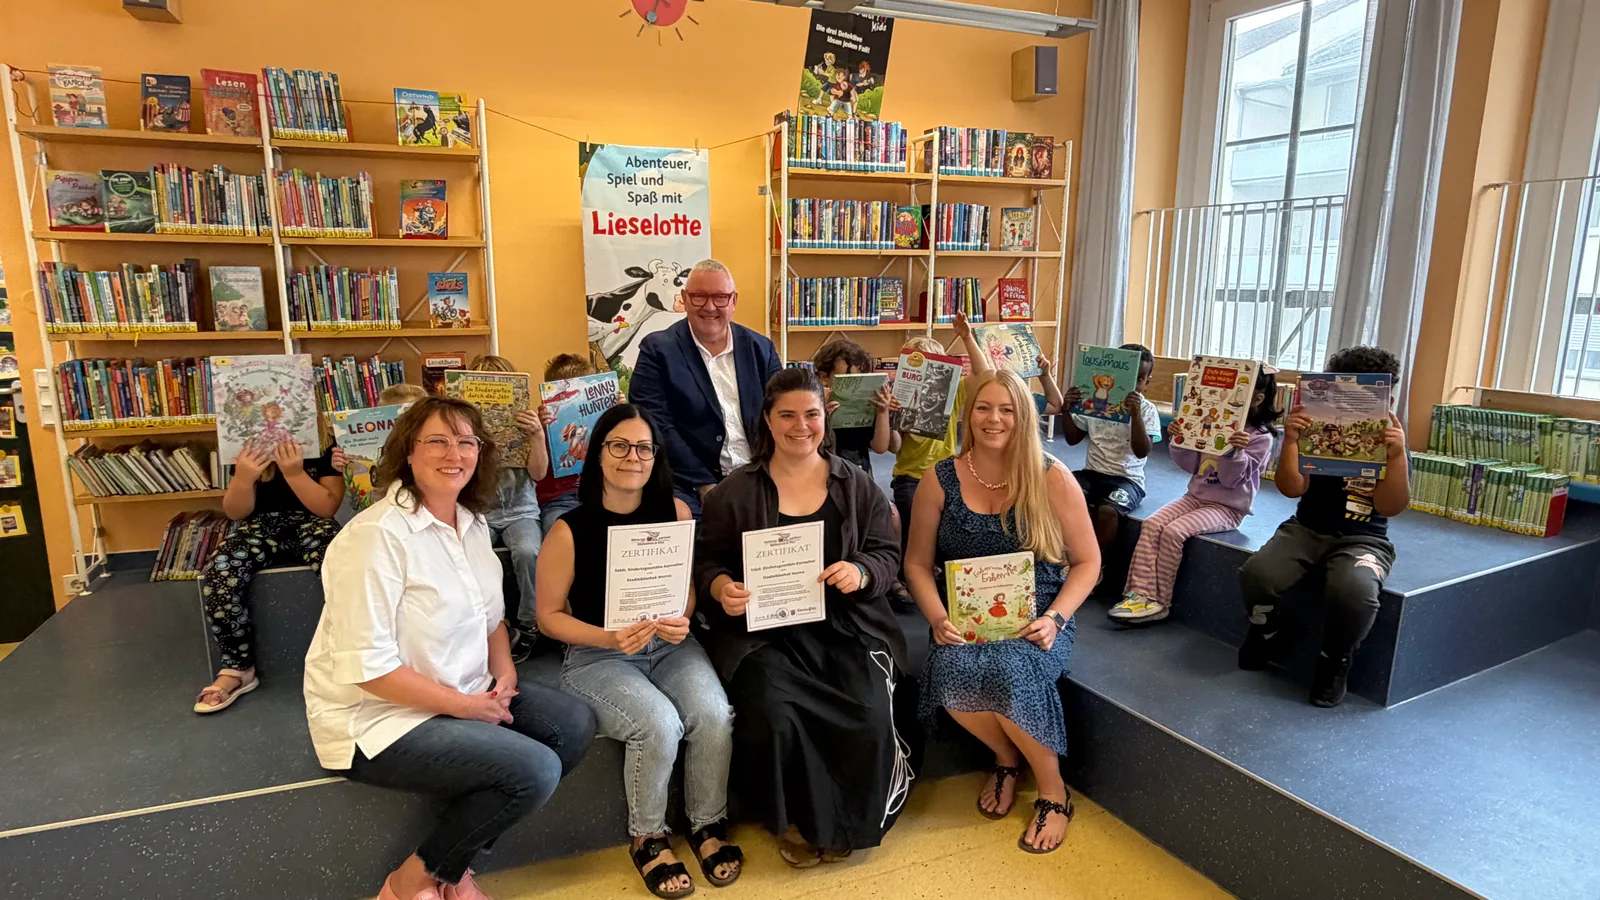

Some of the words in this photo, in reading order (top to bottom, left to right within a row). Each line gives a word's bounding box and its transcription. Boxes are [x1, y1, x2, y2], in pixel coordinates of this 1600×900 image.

[816, 23, 825, 32] Die
[826, 26, 837, 36] drei
[838, 30, 863, 43] Detektive
[871, 21, 887, 32] Kids
[827, 36, 842, 47] lösen
[842, 40, 858, 50] jeden
[858, 44, 871, 54] Fall!
[215, 76, 246, 88] Lesen
[625, 155, 691, 171] Abenteuer,
[607, 173, 637, 188] Spiel
[641, 174, 664, 186] und
[627, 191, 658, 206] Spaß
[662, 192, 683, 204] mit
[592, 210, 702, 237] Lieselotte
[901, 371, 923, 382] BURG
[475, 386, 511, 394] Kindergarten
[347, 419, 395, 435] LEONA
[621, 545, 680, 558] ZERTIFIKAT
[756, 544, 811, 559] ZERTIFIKAT
